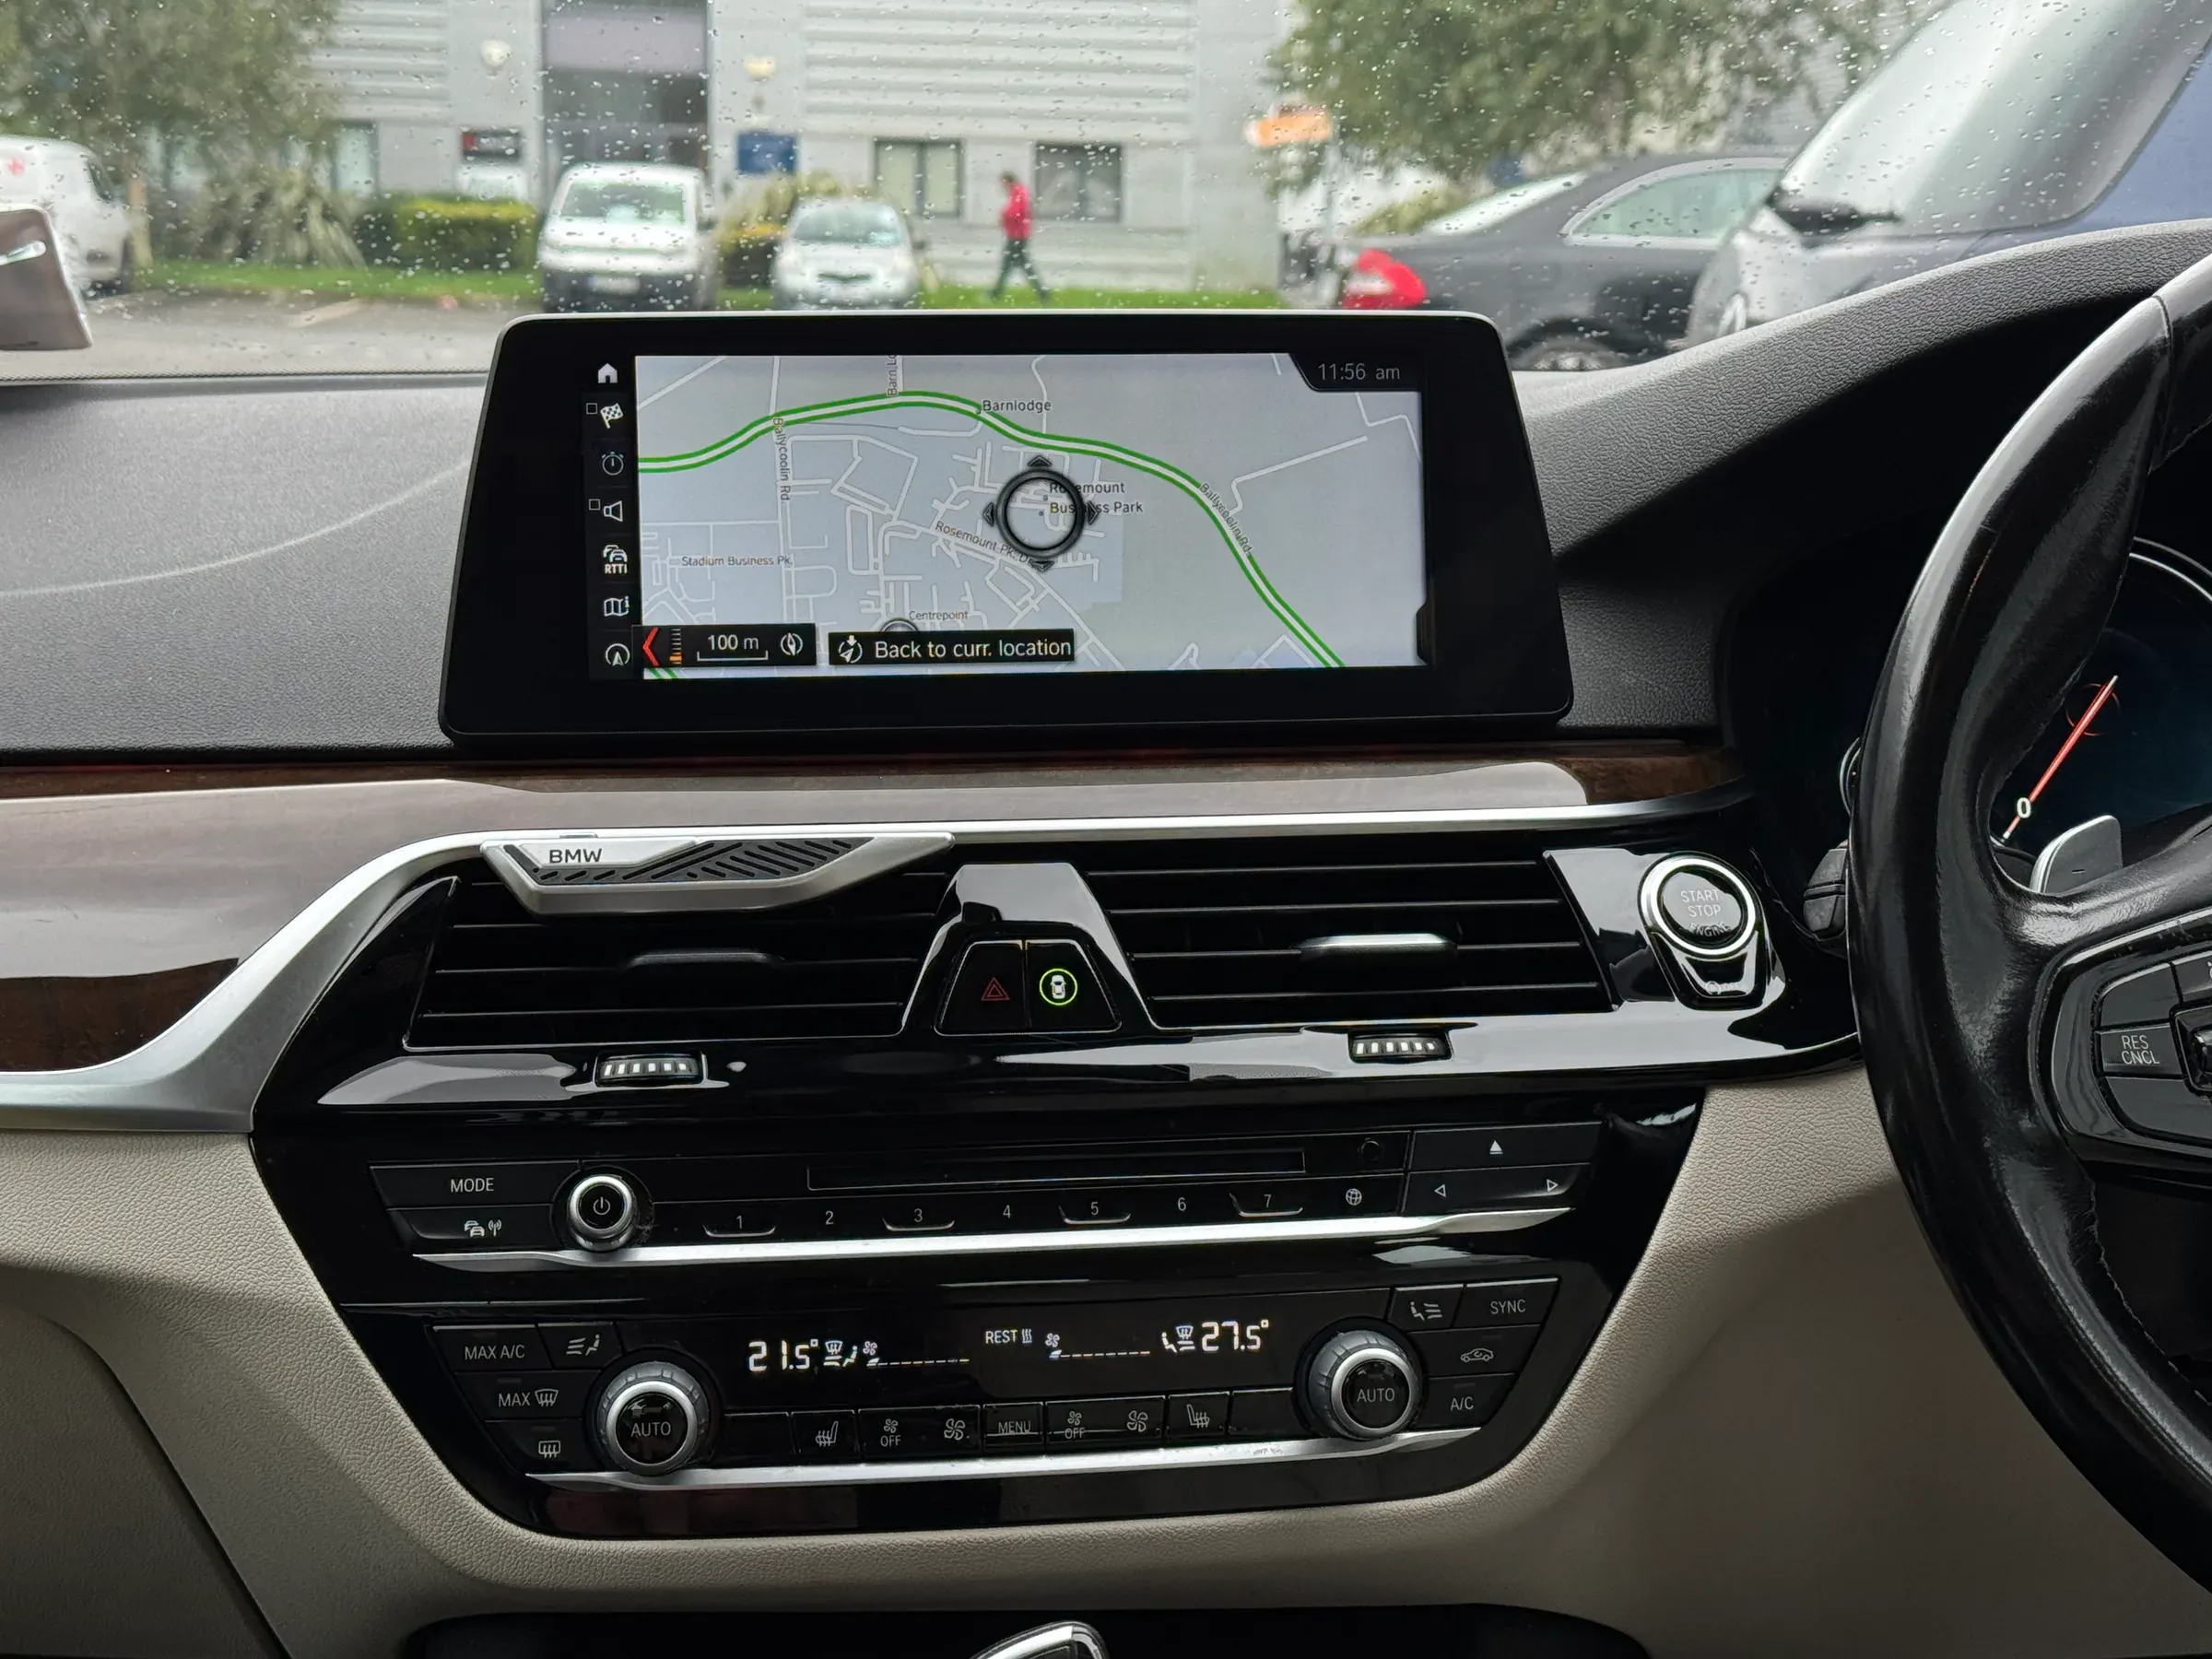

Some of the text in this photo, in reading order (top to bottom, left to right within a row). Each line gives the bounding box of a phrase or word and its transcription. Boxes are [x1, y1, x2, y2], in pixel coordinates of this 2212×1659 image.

[1317, 363, 1400, 381] 11:56 am
[888, 370, 897, 396] Barn
[982, 399, 1051, 413] Barnlodge
[773, 418, 790, 481] Ballycoolin
[1050, 482, 1124, 494] Roemount
[1050, 501, 1143, 513] Busss Park
[1200, 483, 1241, 537] Ballycoolin
[935, 521, 997, 551] Rosemount
[605, 563, 628, 573] RTTI
[682, 556, 724, 567] Stadium
[727, 555, 774, 566] Business
[909, 610, 968, 622] Centrepoint
[708, 635, 759, 650] 100 m
[876, 639, 1071, 658] Back to curr. location
[2017, 797, 2031, 818] 0
[549, 848, 602, 864] BMW
[1680, 889, 1719, 902] START
[1688, 904, 1721, 917] STOP
[1688, 923, 1731, 936] ENGINE
[2122, 1035, 2148, 1049] RES
[2121, 1051, 2160, 1065] CNCL
[450, 1178, 495, 1193] MODE
[1178, 1198, 1186, 1211] 6
[1264, 1194, 1272, 1208] 7
[913, 1209, 923, 1223] 3
[1003, 1206, 1011, 1218] 4
[1090, 1202, 1100, 1216] 5
[735, 1215, 743, 1230] 1
[825, 1211, 834, 1225] 2
[1489, 1300, 1526, 1315] SYNC
[985, 1329, 1018, 1345] REST
[465, 1344, 525, 1360] MAX A/C
[499, 1391, 530, 1406] MAX
[1357, 1387, 1395, 1404] AUTO
[1451, 1395, 1474, 1412] A/C
[630, 1420, 672, 1438] AUTO
[997, 1419, 1031, 1435] MENU
[1065, 1428, 1085, 1441] OFF
[880, 1433, 900, 1448] OFF
